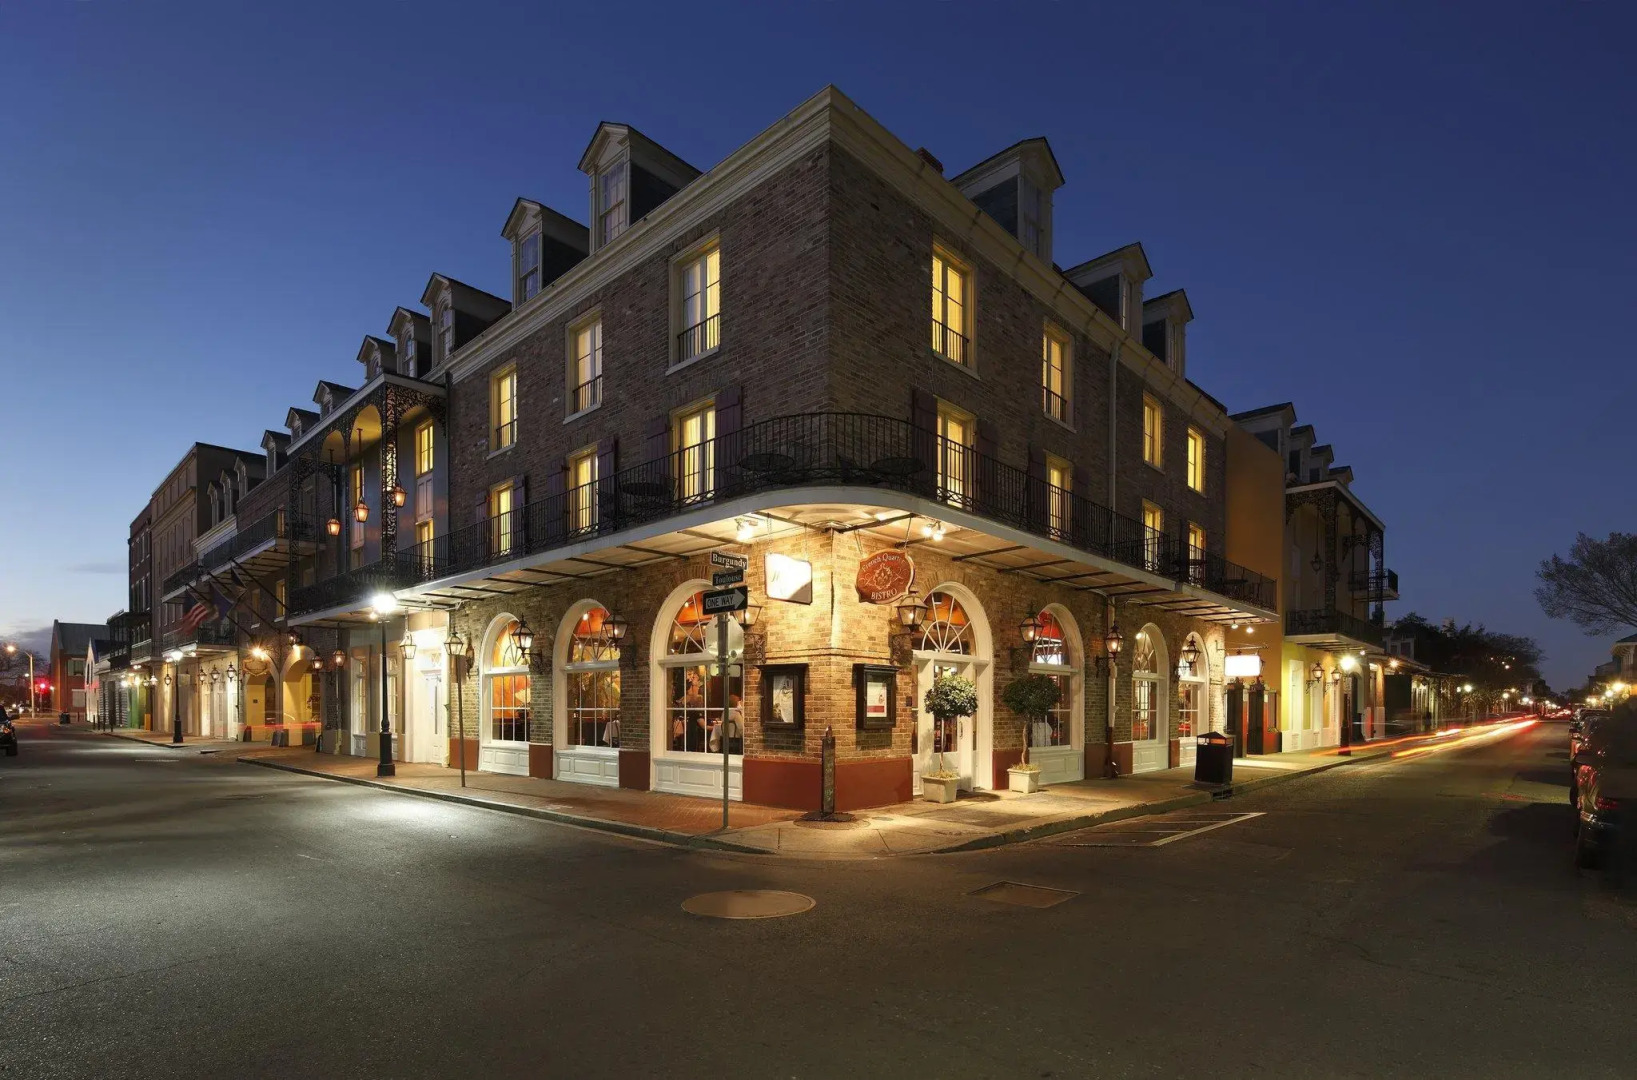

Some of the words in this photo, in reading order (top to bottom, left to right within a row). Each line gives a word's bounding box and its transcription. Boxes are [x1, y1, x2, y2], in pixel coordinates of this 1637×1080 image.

[713, 553, 747, 568] Burgundy
[862, 557, 882, 572] French
[715, 575, 742, 585] Toulouse
[871, 588, 898, 600] BISTRO
[707, 597, 720, 608] ONE
[721, 595, 734, 606] WAY
